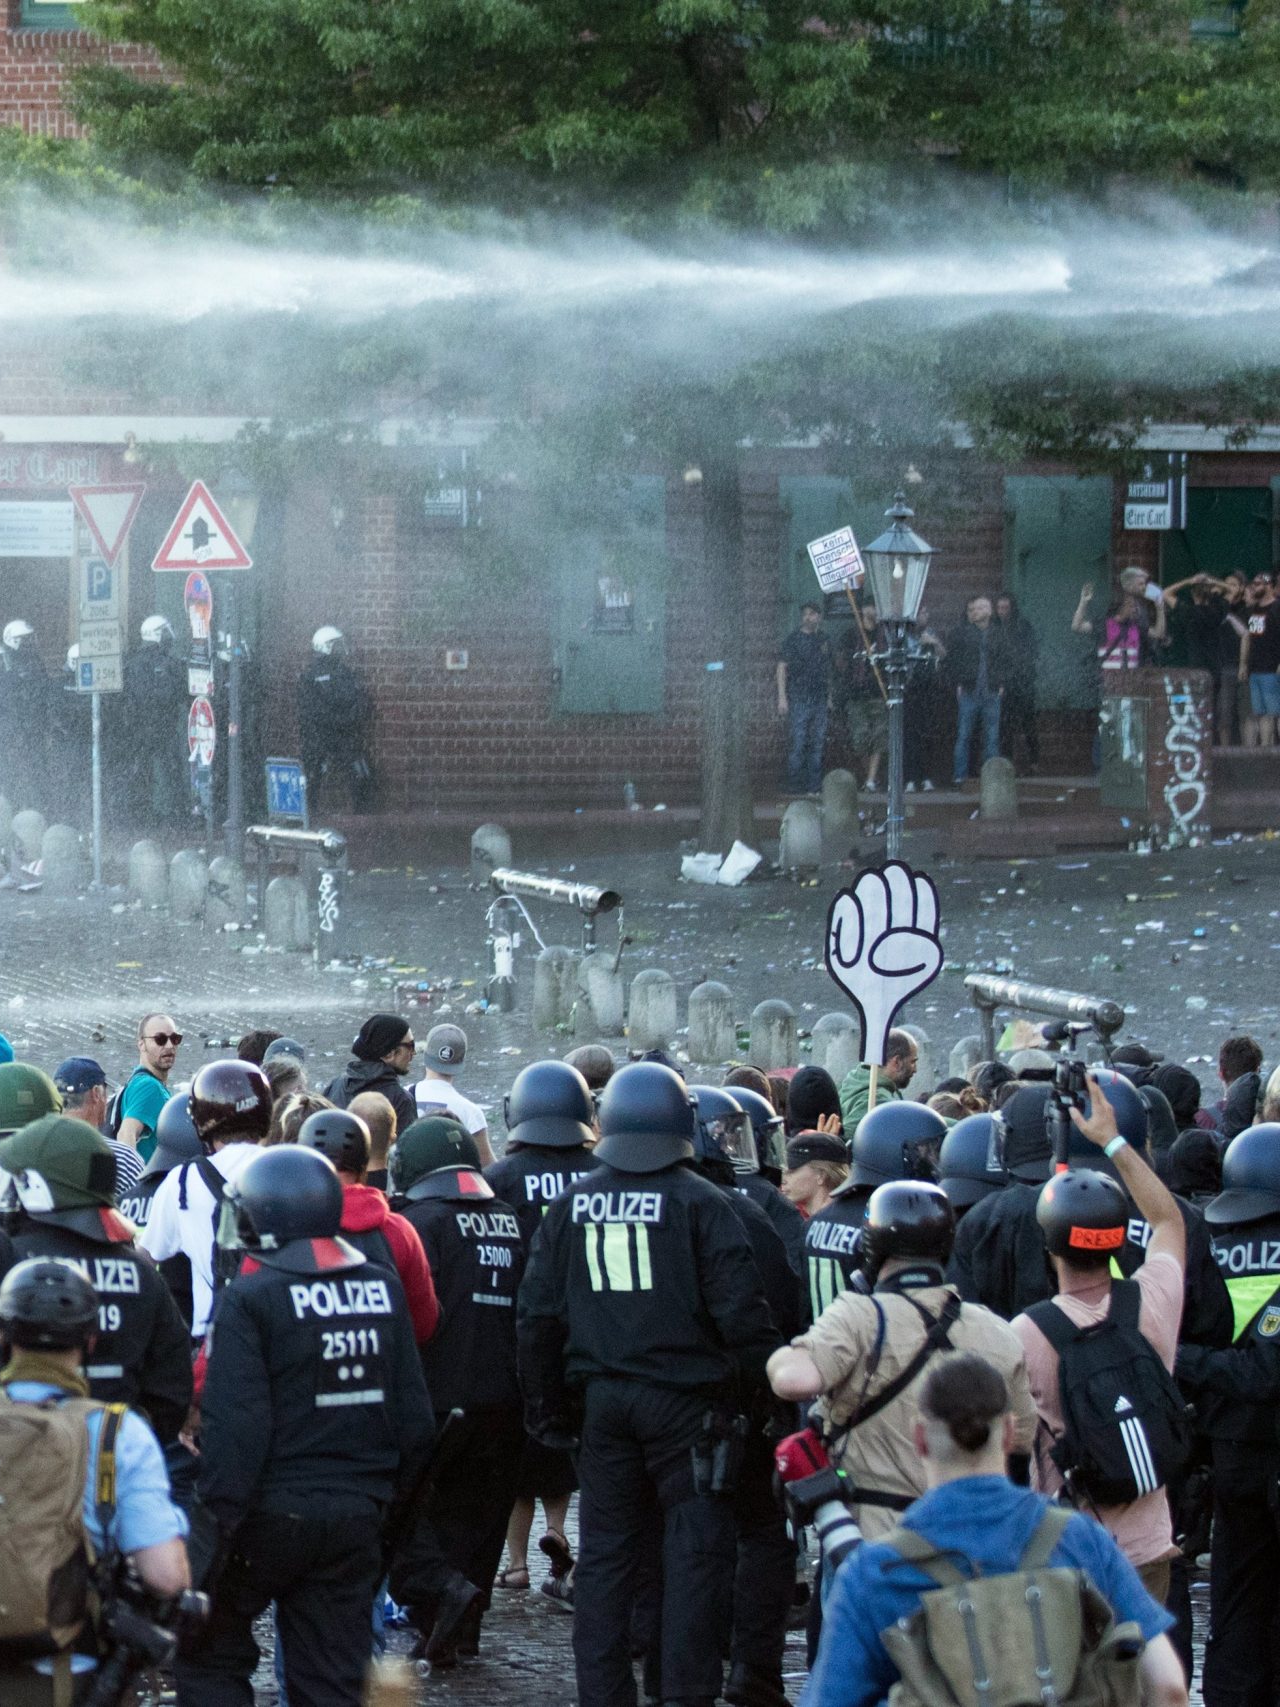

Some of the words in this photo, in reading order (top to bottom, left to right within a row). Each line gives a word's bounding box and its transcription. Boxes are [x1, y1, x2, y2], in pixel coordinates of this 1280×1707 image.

[25, 449, 101, 486] Carl
[816, 541, 854, 565] mensch
[822, 535, 844, 550] kein
[92, 566, 106, 596] P
[89, 605, 110, 618] ZONE
[572, 1191, 663, 1224] POLIZEI
[456, 1211, 520, 1240] POLIZEI
[805, 1218, 862, 1256] POLIZEI
[1073, 1228, 1121, 1248] PRESS
[477, 1244, 512, 1268] 25000
[290, 1280, 392, 1319] POLIZEI
[98, 1304, 121, 1331] 19
[321, 1328, 380, 1361] 25111
